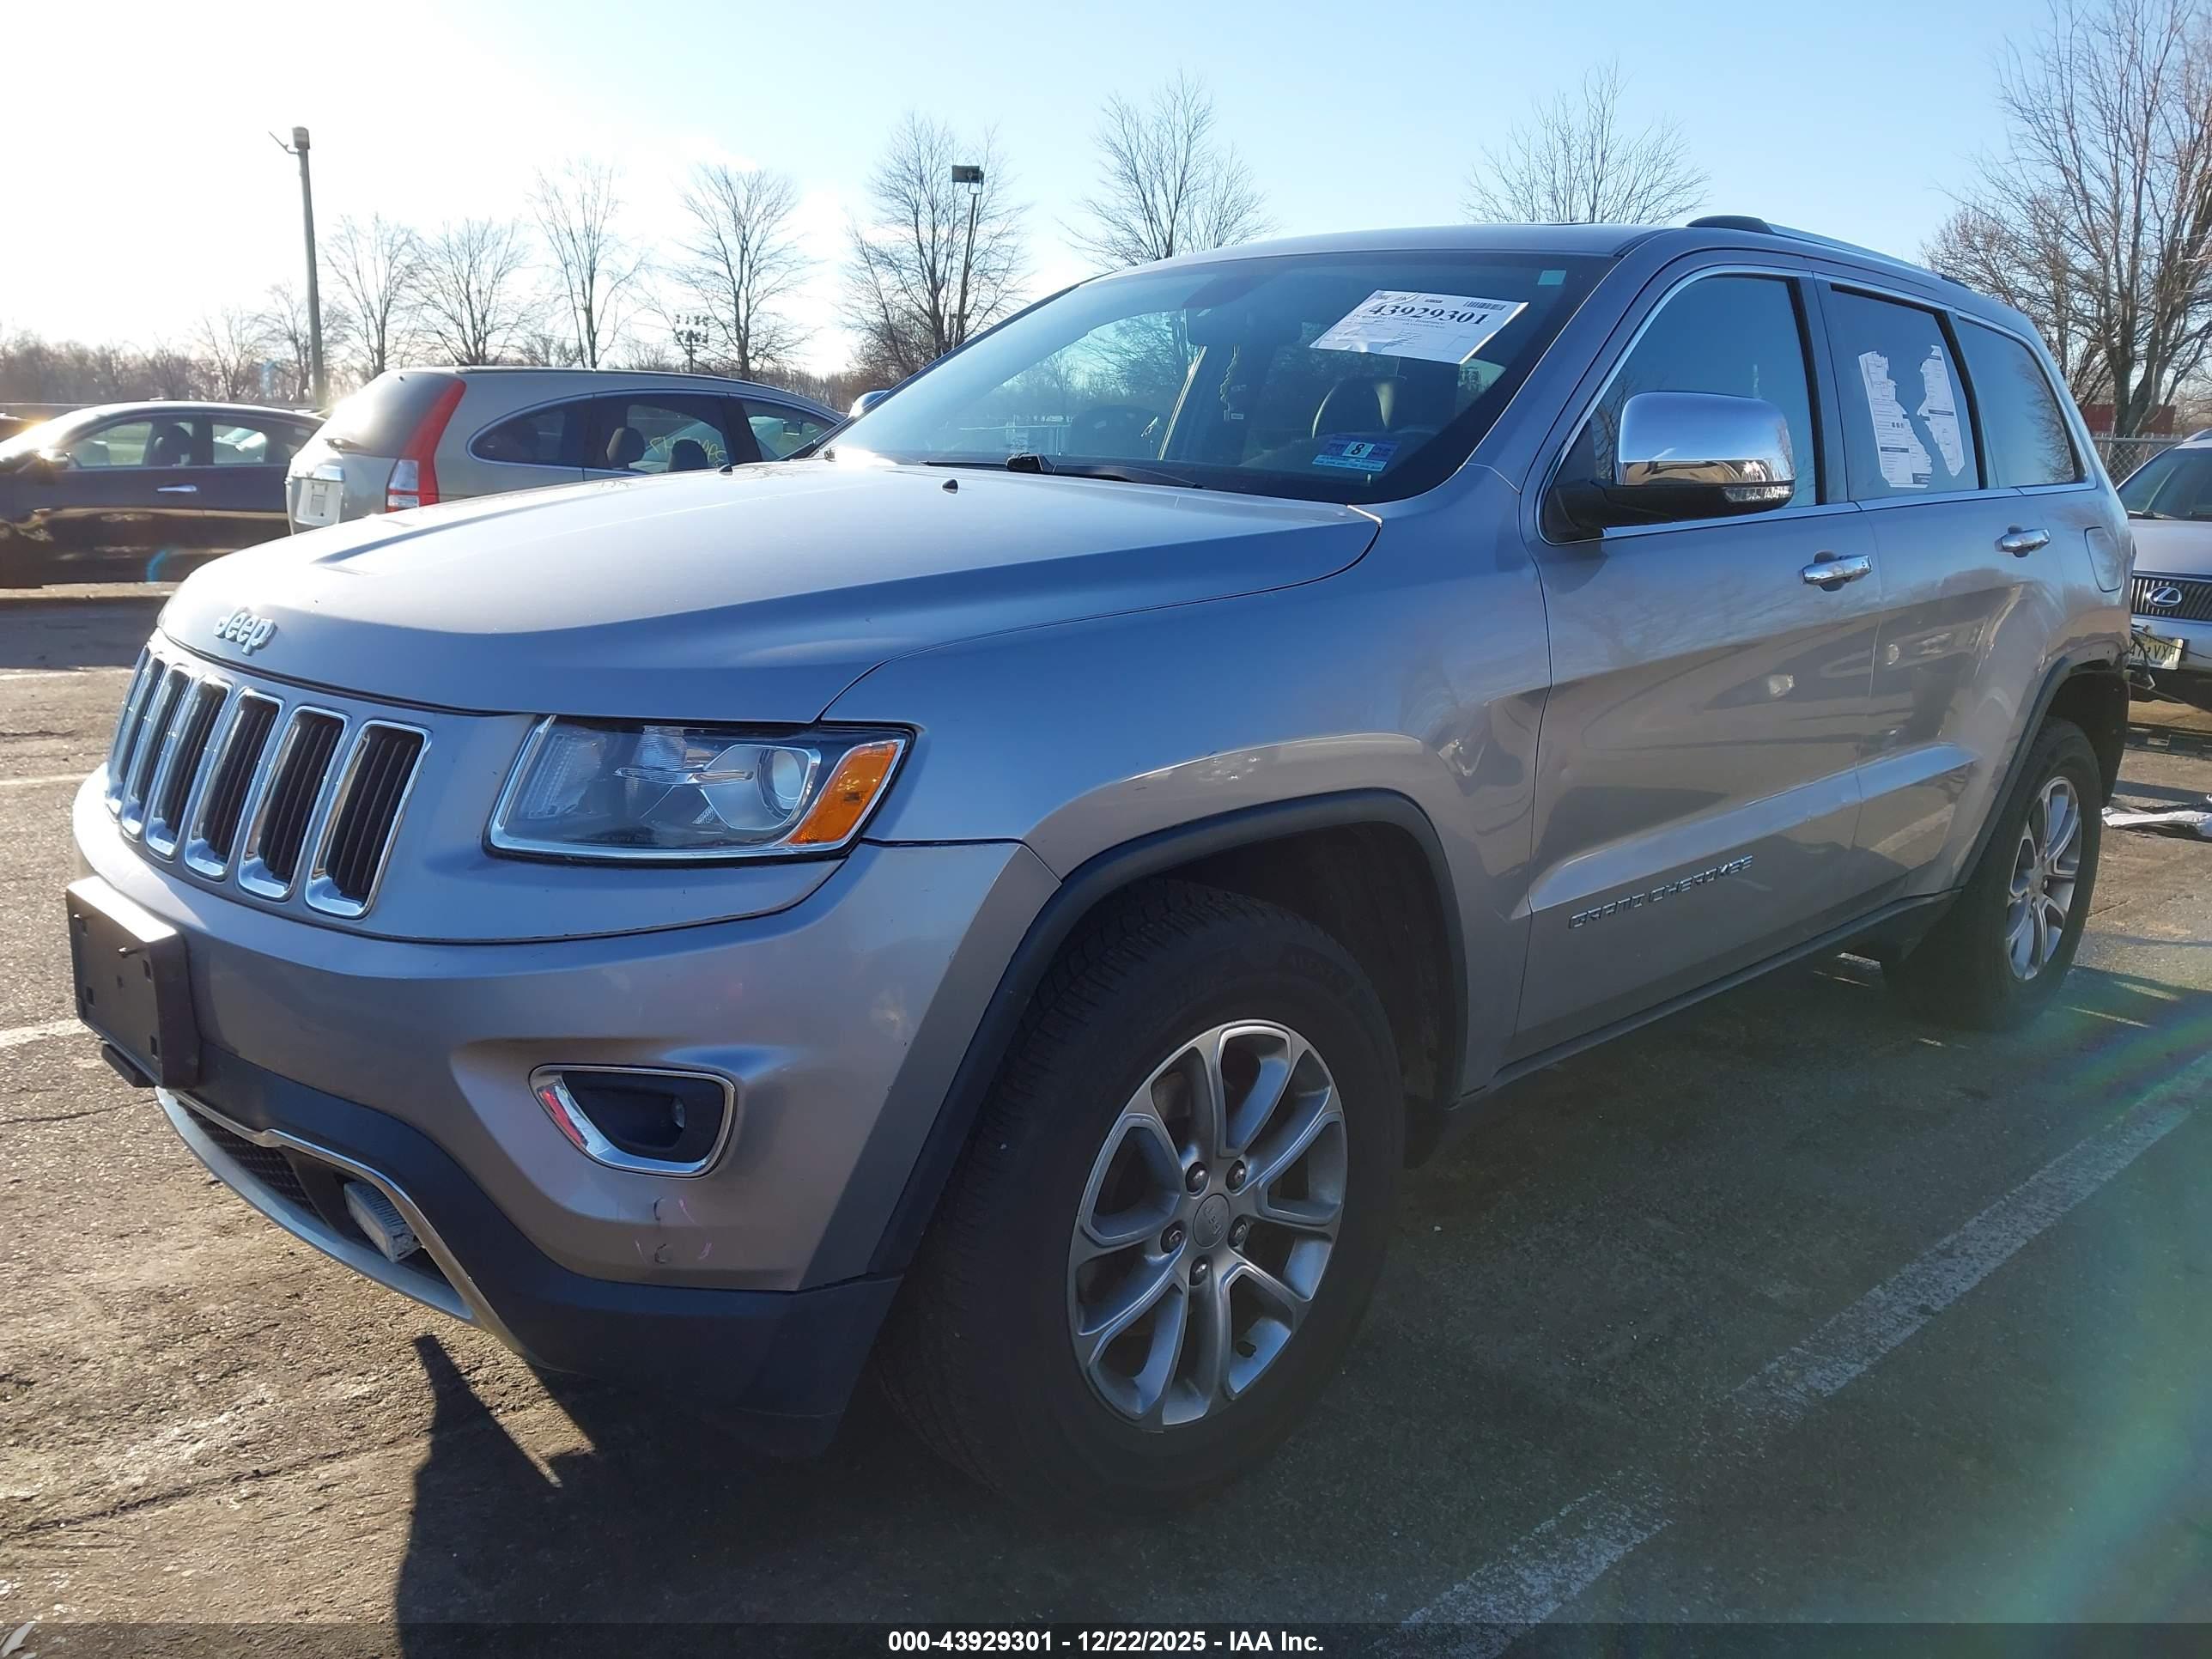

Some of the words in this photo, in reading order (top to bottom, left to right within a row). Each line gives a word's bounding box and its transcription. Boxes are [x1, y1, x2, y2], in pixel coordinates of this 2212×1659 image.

[1368, 305, 1490, 325] 43929301
[1351, 443, 1365, 456] 8
[213, 606, 277, 656] Jeep
[1568, 893, 1645, 929] GRAND
[1648, 855, 1753, 902] CHEROKEE
